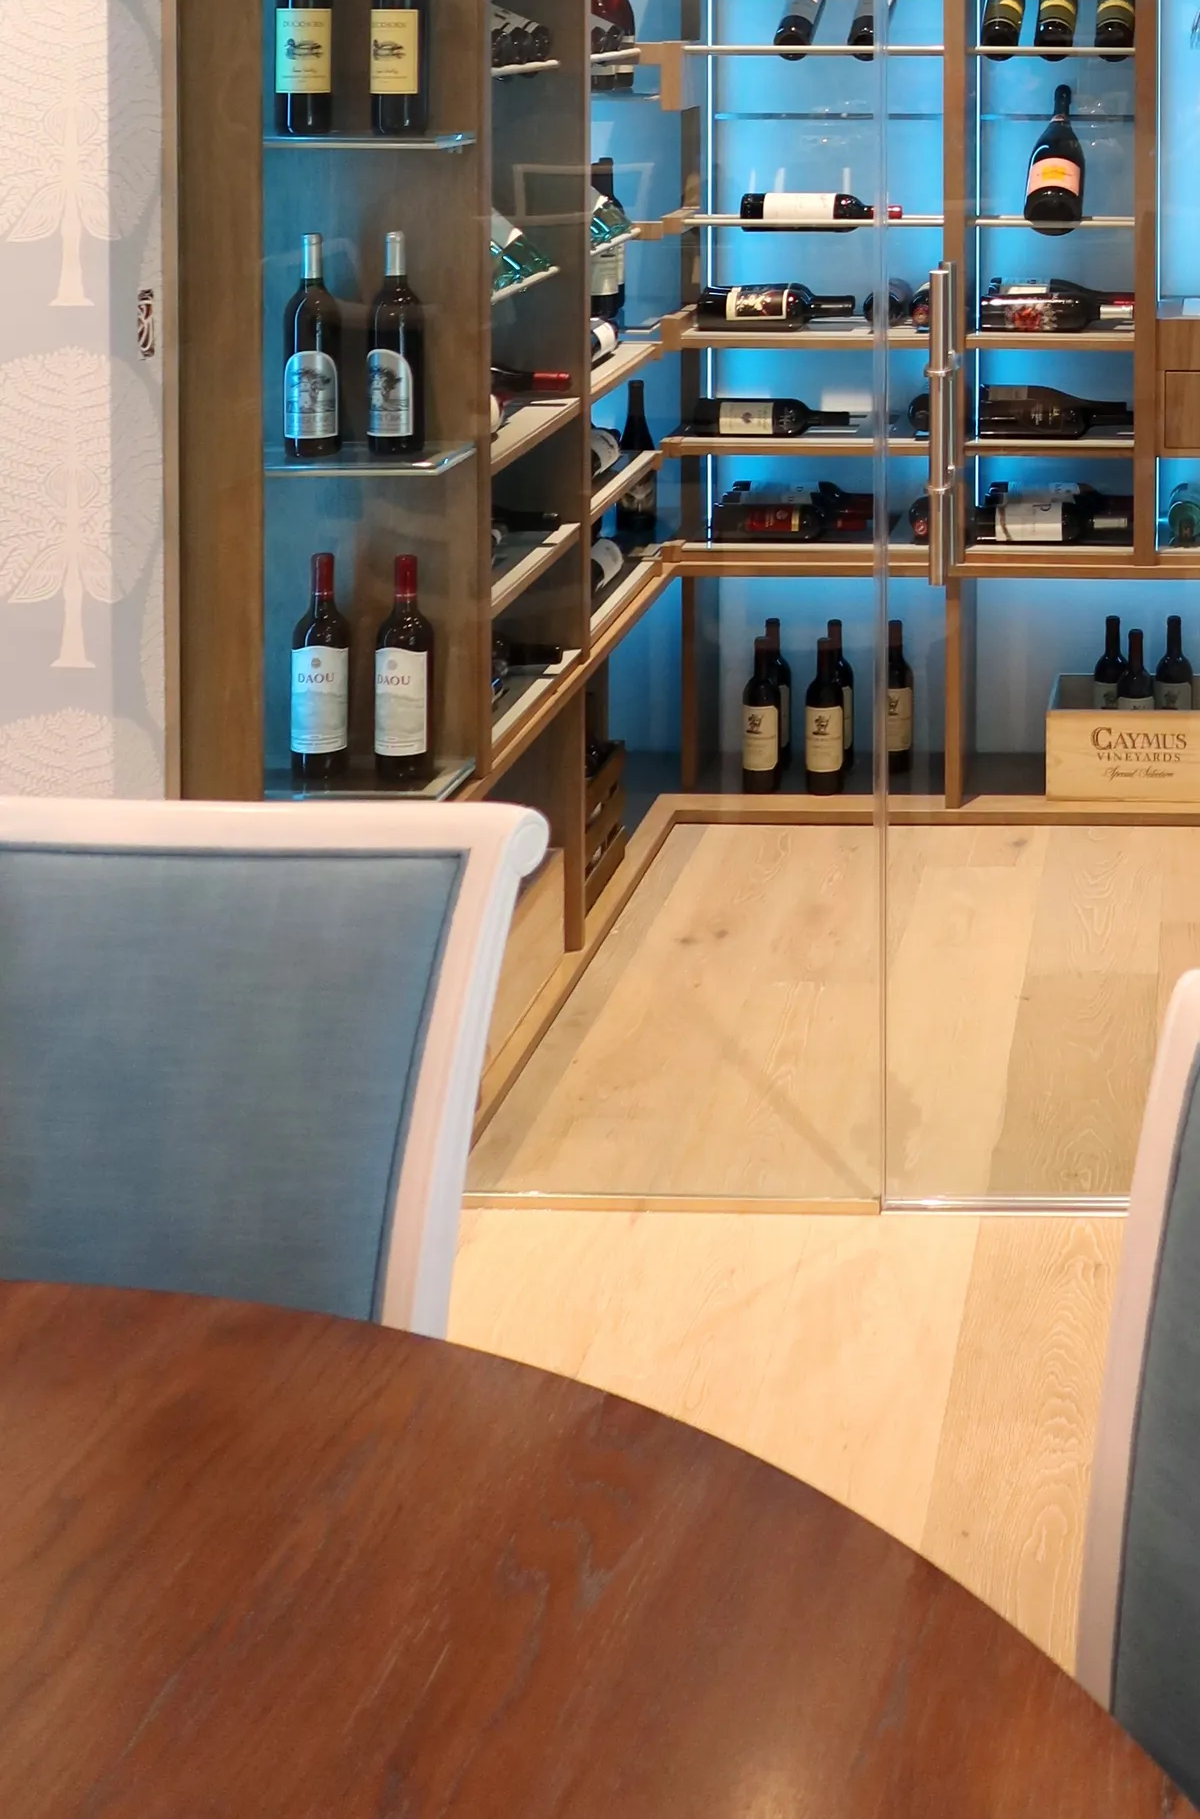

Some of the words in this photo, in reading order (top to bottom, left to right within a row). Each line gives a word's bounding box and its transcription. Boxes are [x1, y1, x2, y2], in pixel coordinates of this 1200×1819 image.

[297, 672, 335, 684] DAOU
[377, 673, 411, 686] DAOU
[1090, 726, 1188, 751] CAYMUS
[1096, 752, 1182, 762] VINEYARDS
